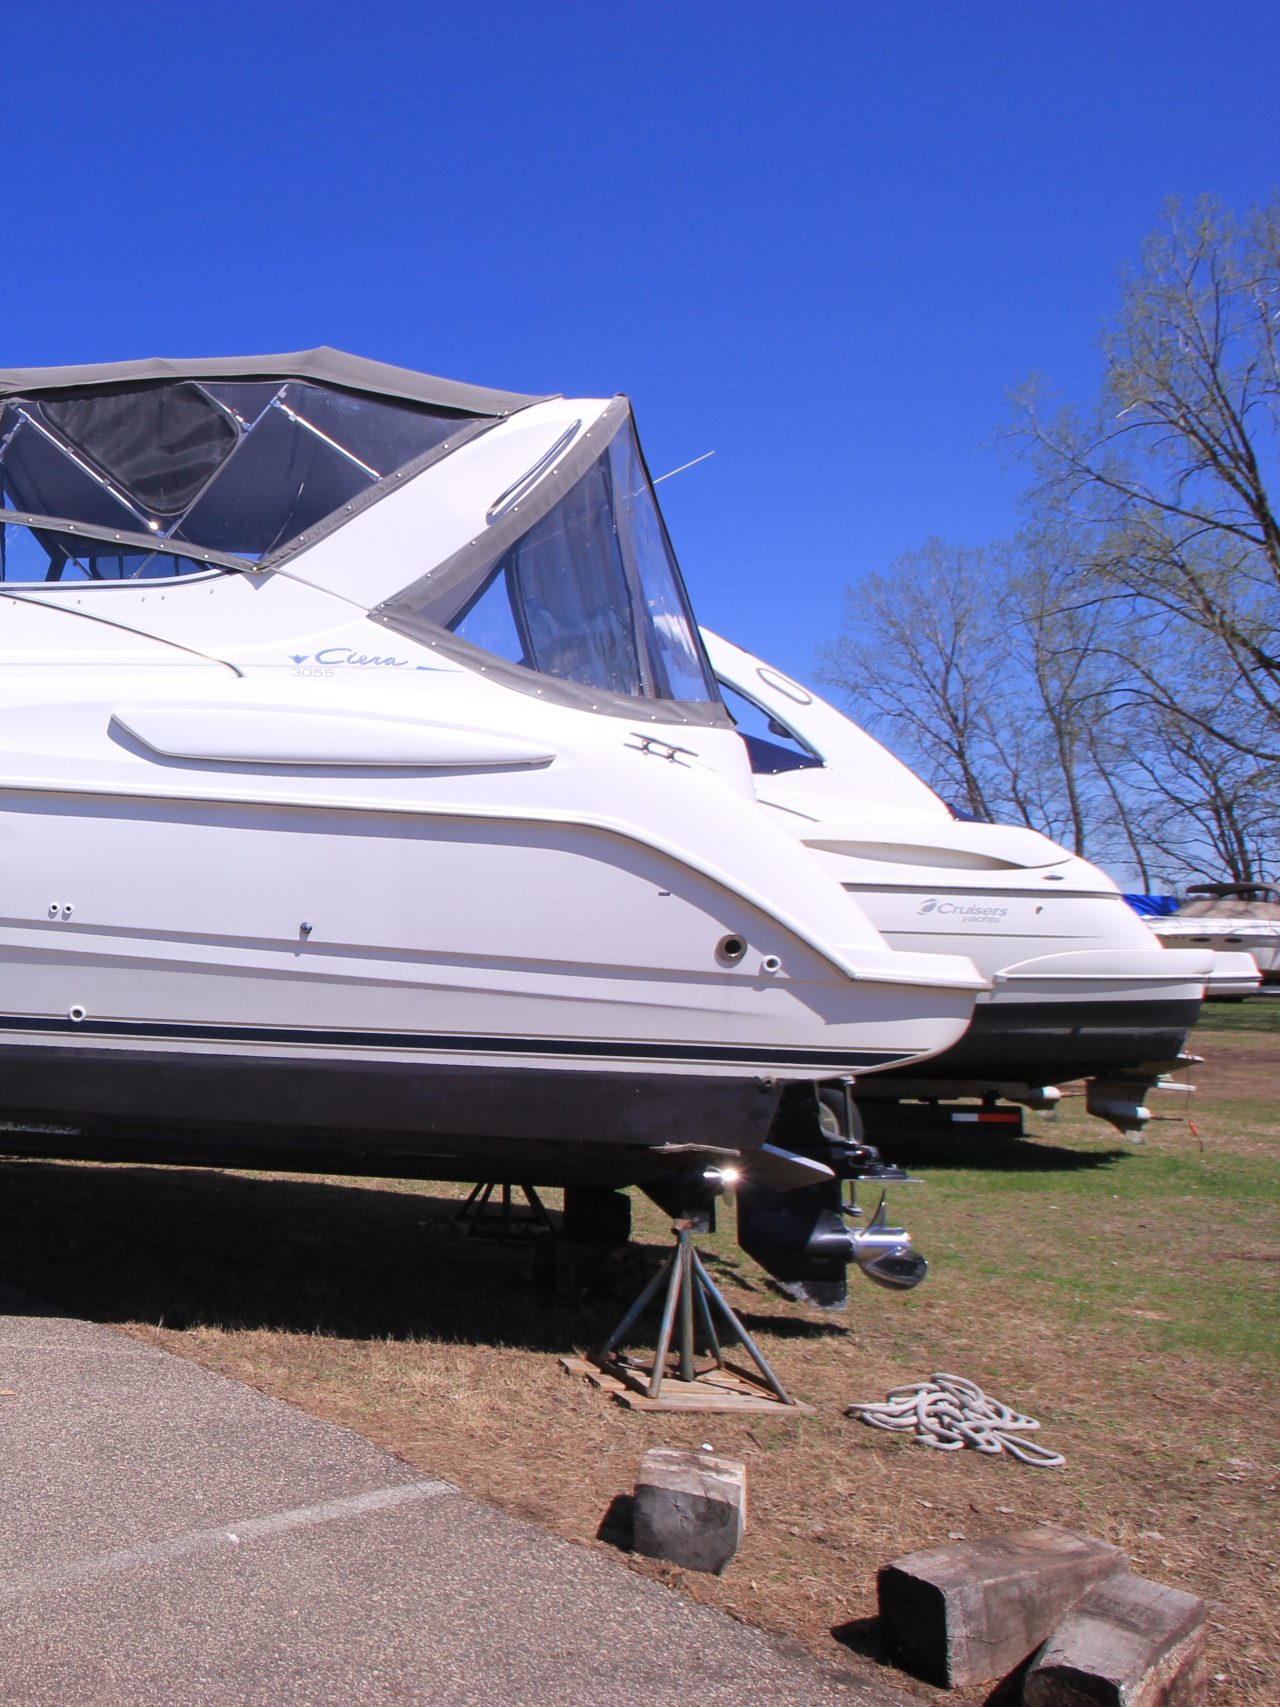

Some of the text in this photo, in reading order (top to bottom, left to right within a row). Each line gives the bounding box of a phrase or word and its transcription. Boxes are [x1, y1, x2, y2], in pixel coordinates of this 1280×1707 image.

[315, 648, 408, 666] Ciera
[291, 668, 334, 678] 3055
[937, 903, 1008, 917] Cruisers
[962, 916, 1001, 924] yachts
